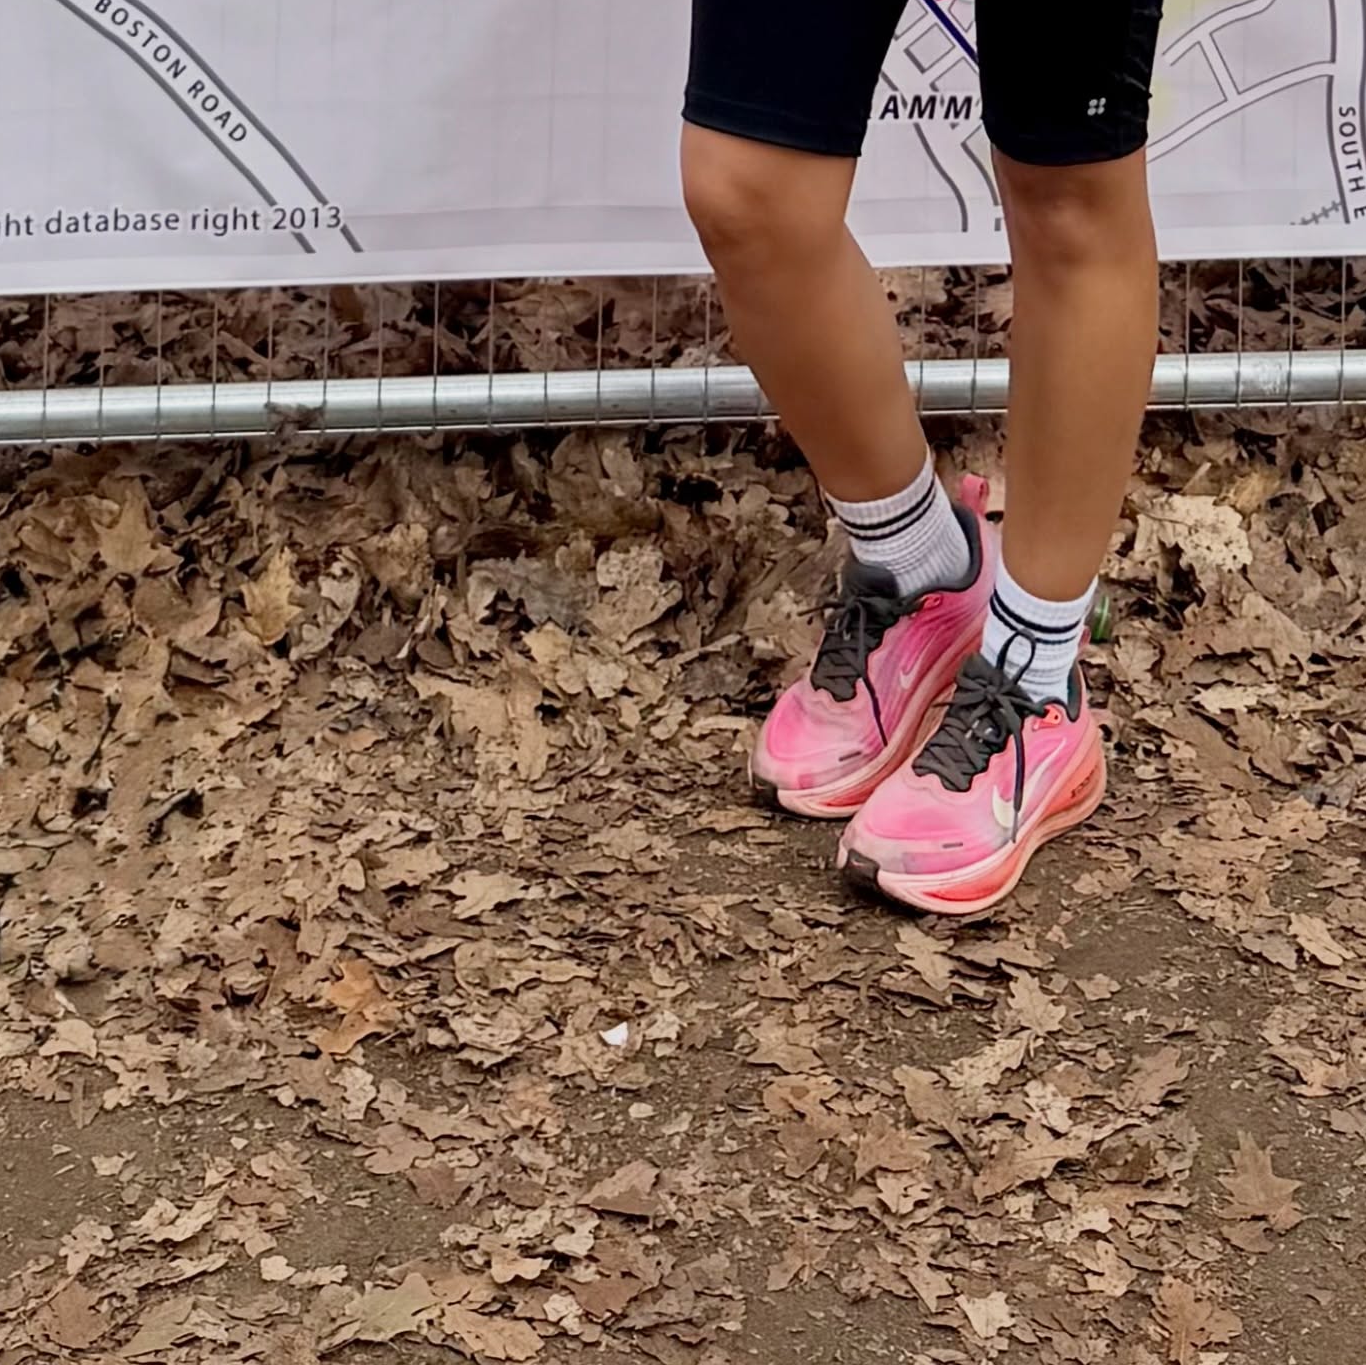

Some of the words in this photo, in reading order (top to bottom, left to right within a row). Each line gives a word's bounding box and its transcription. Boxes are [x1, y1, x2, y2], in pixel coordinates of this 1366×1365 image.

[187, 80, 247, 144] ROAD
[45, 212, 179, 238] database
[191, 210, 260, 239] right
[272, 210, 341, 234] 2013
